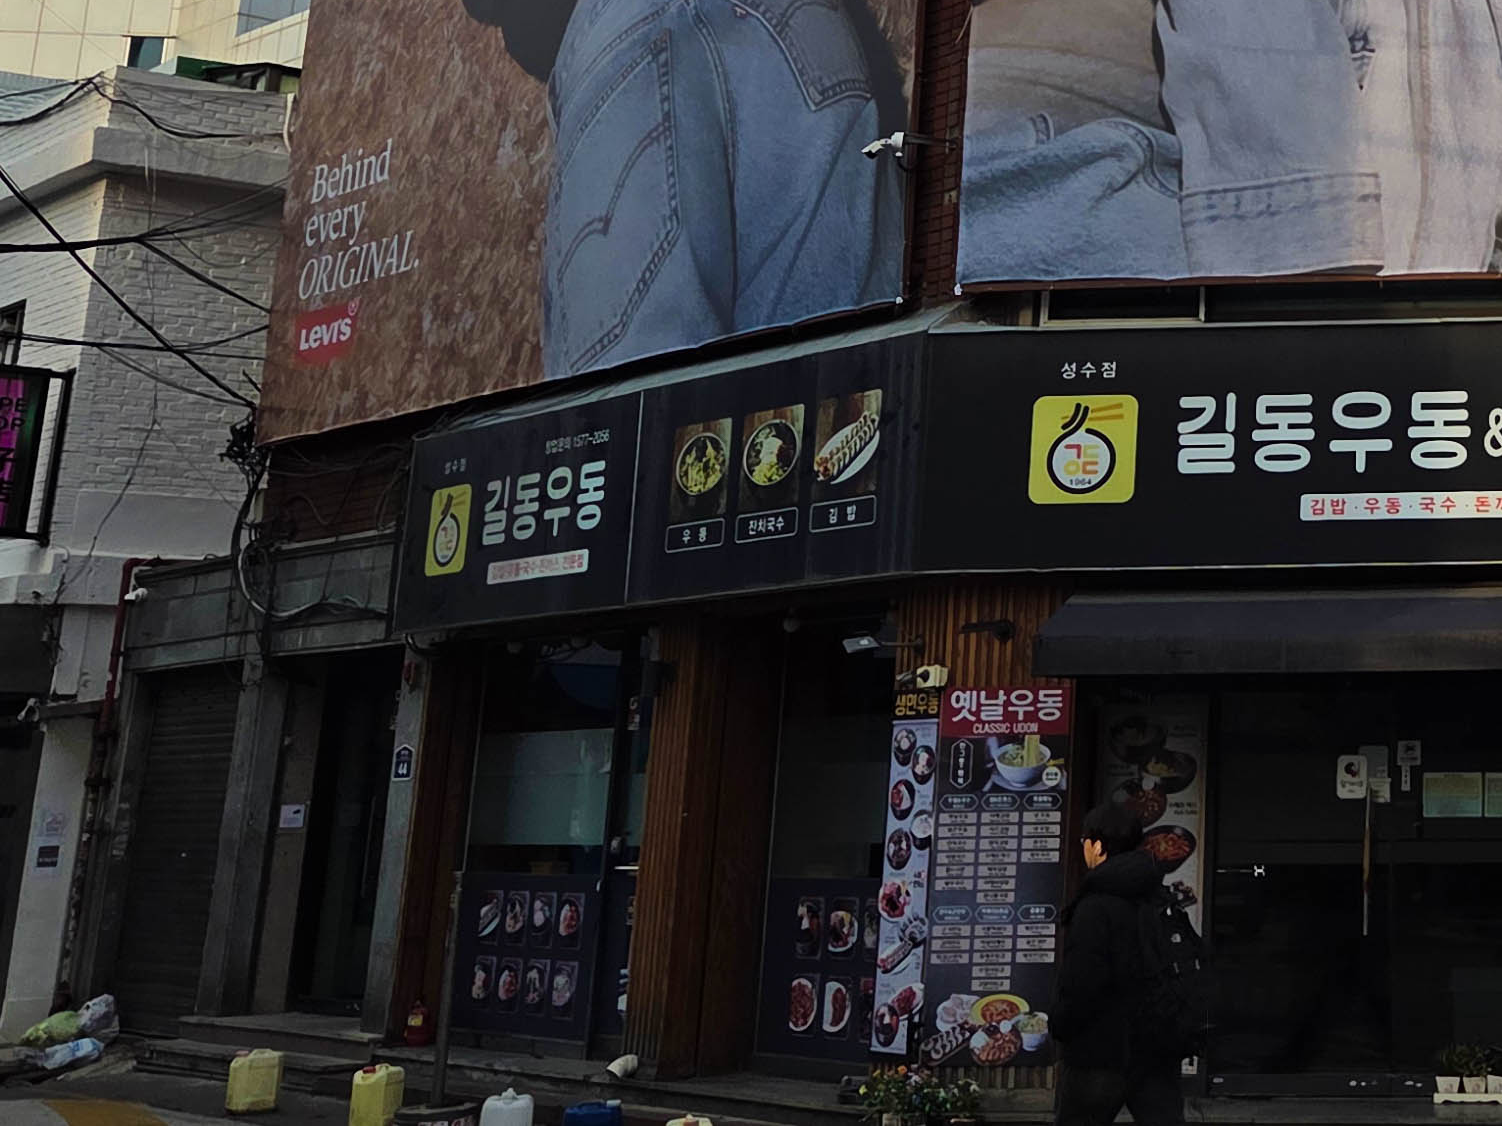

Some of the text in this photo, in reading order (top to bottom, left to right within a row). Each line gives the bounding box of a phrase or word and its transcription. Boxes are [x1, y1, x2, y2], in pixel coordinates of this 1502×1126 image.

[310, 137, 393, 205] Behind
[304, 200, 367, 248] every
[298, 230, 420, 301] ORIGINAL.
[1061, 361, 1118, 379] 성수점
[482, 460, 607, 546] 길동우동
[1310, 498, 1347, 516] 김밥
[1363, 497, 1401, 515] 우동
[1418, 496, 1457, 514] 국수
[951, 689, 1064, 722] 옛날우동
[972, 722, 1011, 734] CLASSIC
